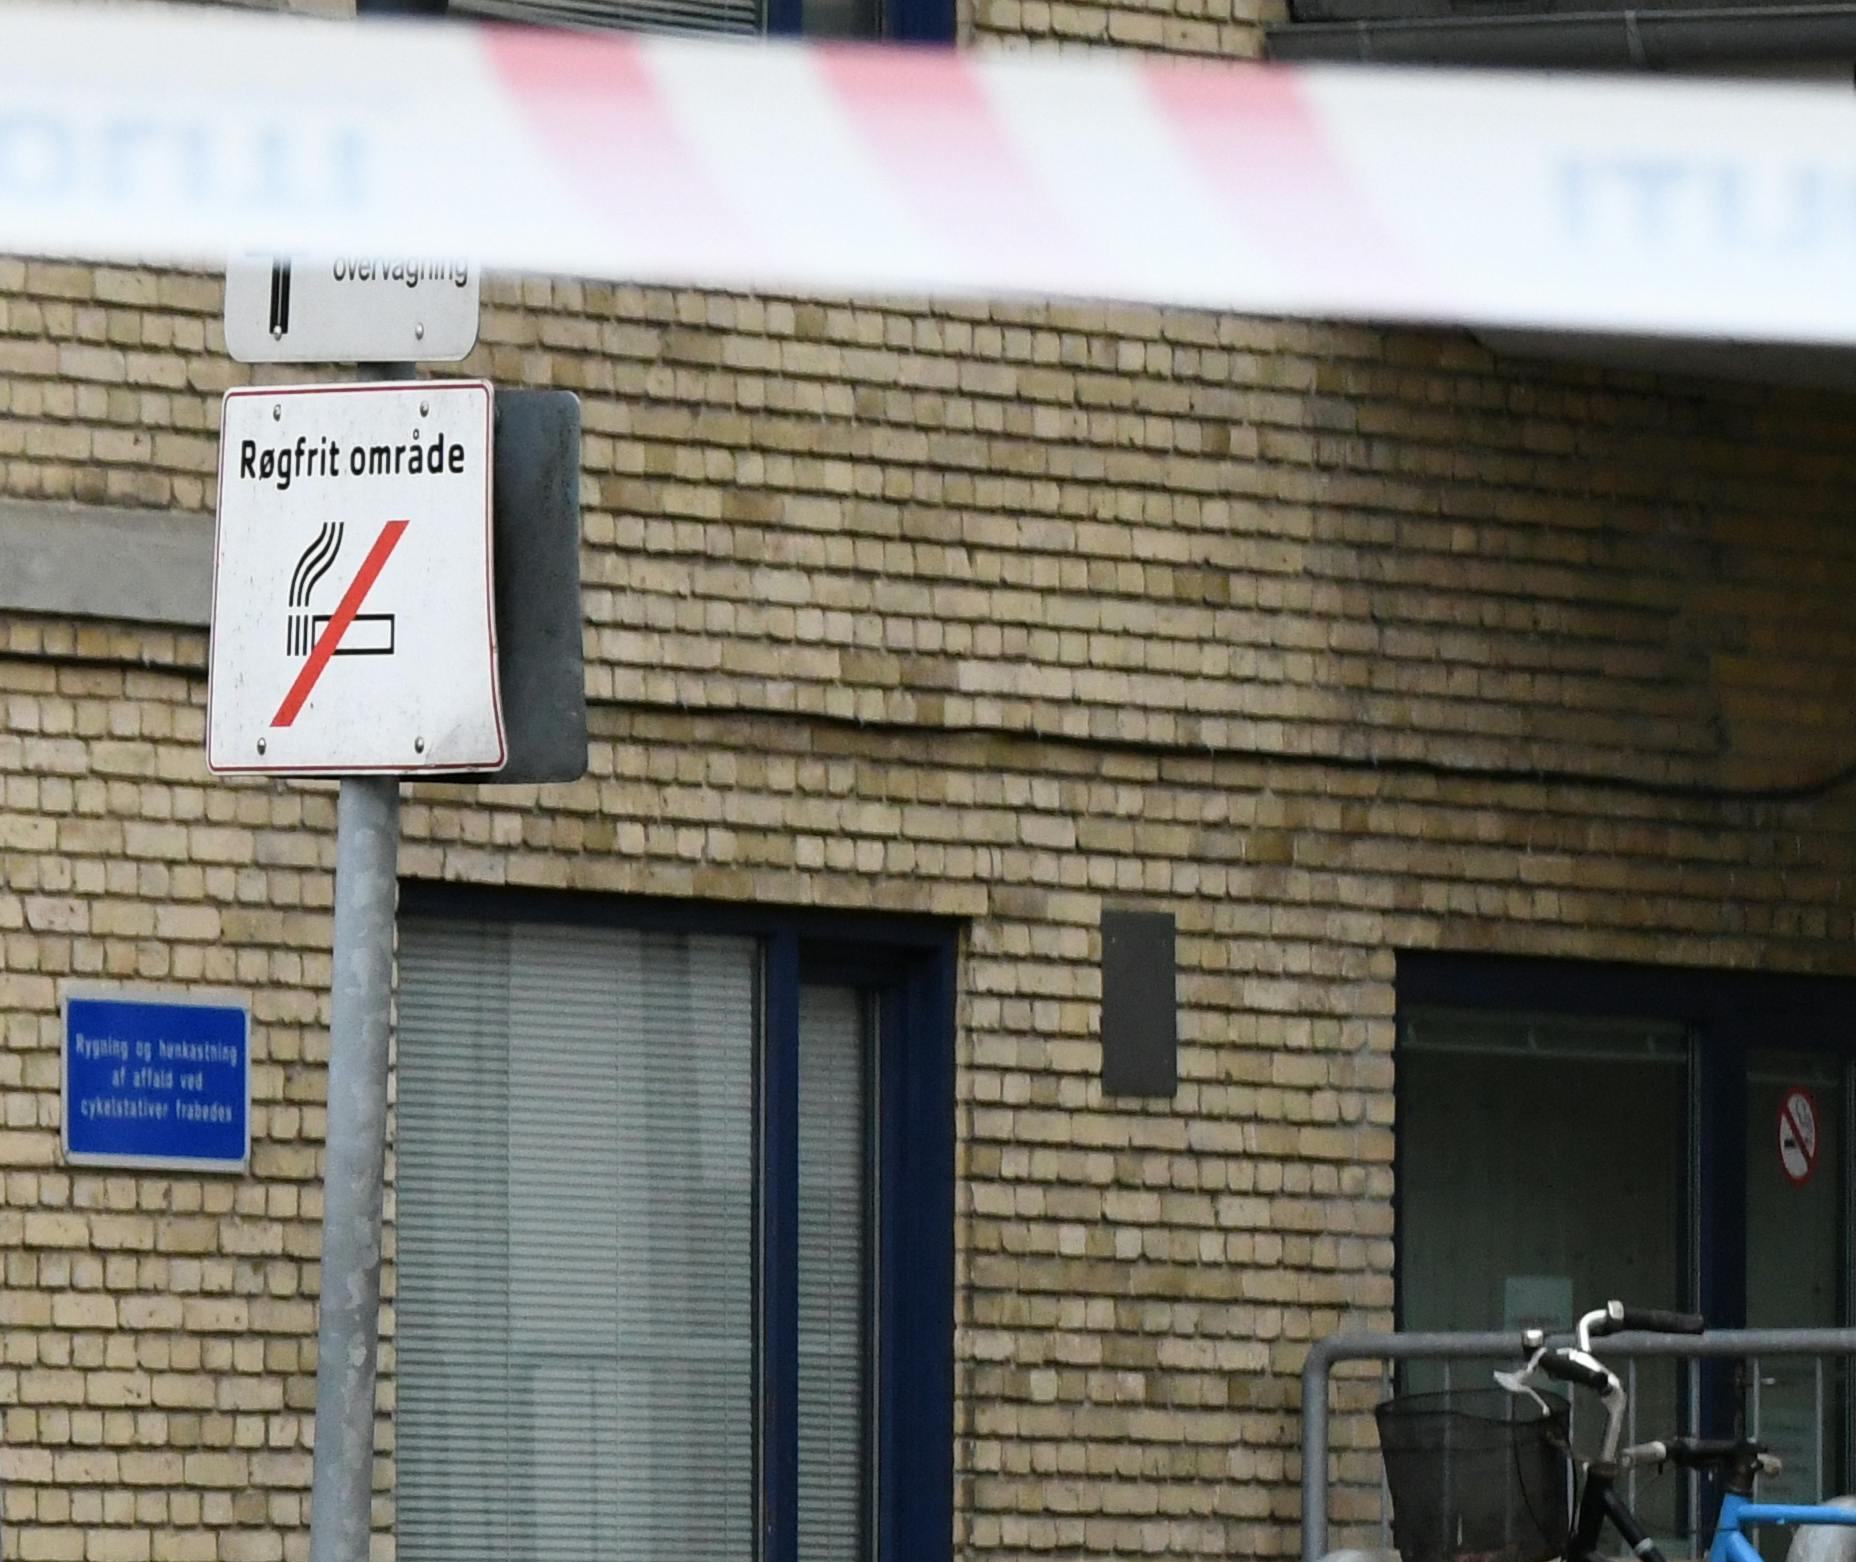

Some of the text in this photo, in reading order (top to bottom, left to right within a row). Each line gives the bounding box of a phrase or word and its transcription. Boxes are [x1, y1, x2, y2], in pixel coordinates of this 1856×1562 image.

[240, 428, 464, 490] Røgfrit område
[75, 1033, 128, 1061] Rygning
[136, 1040, 151, 1062] og
[112, 1066, 203, 1091] af affald ved
[80, 1096, 168, 1120] cykelstativer
